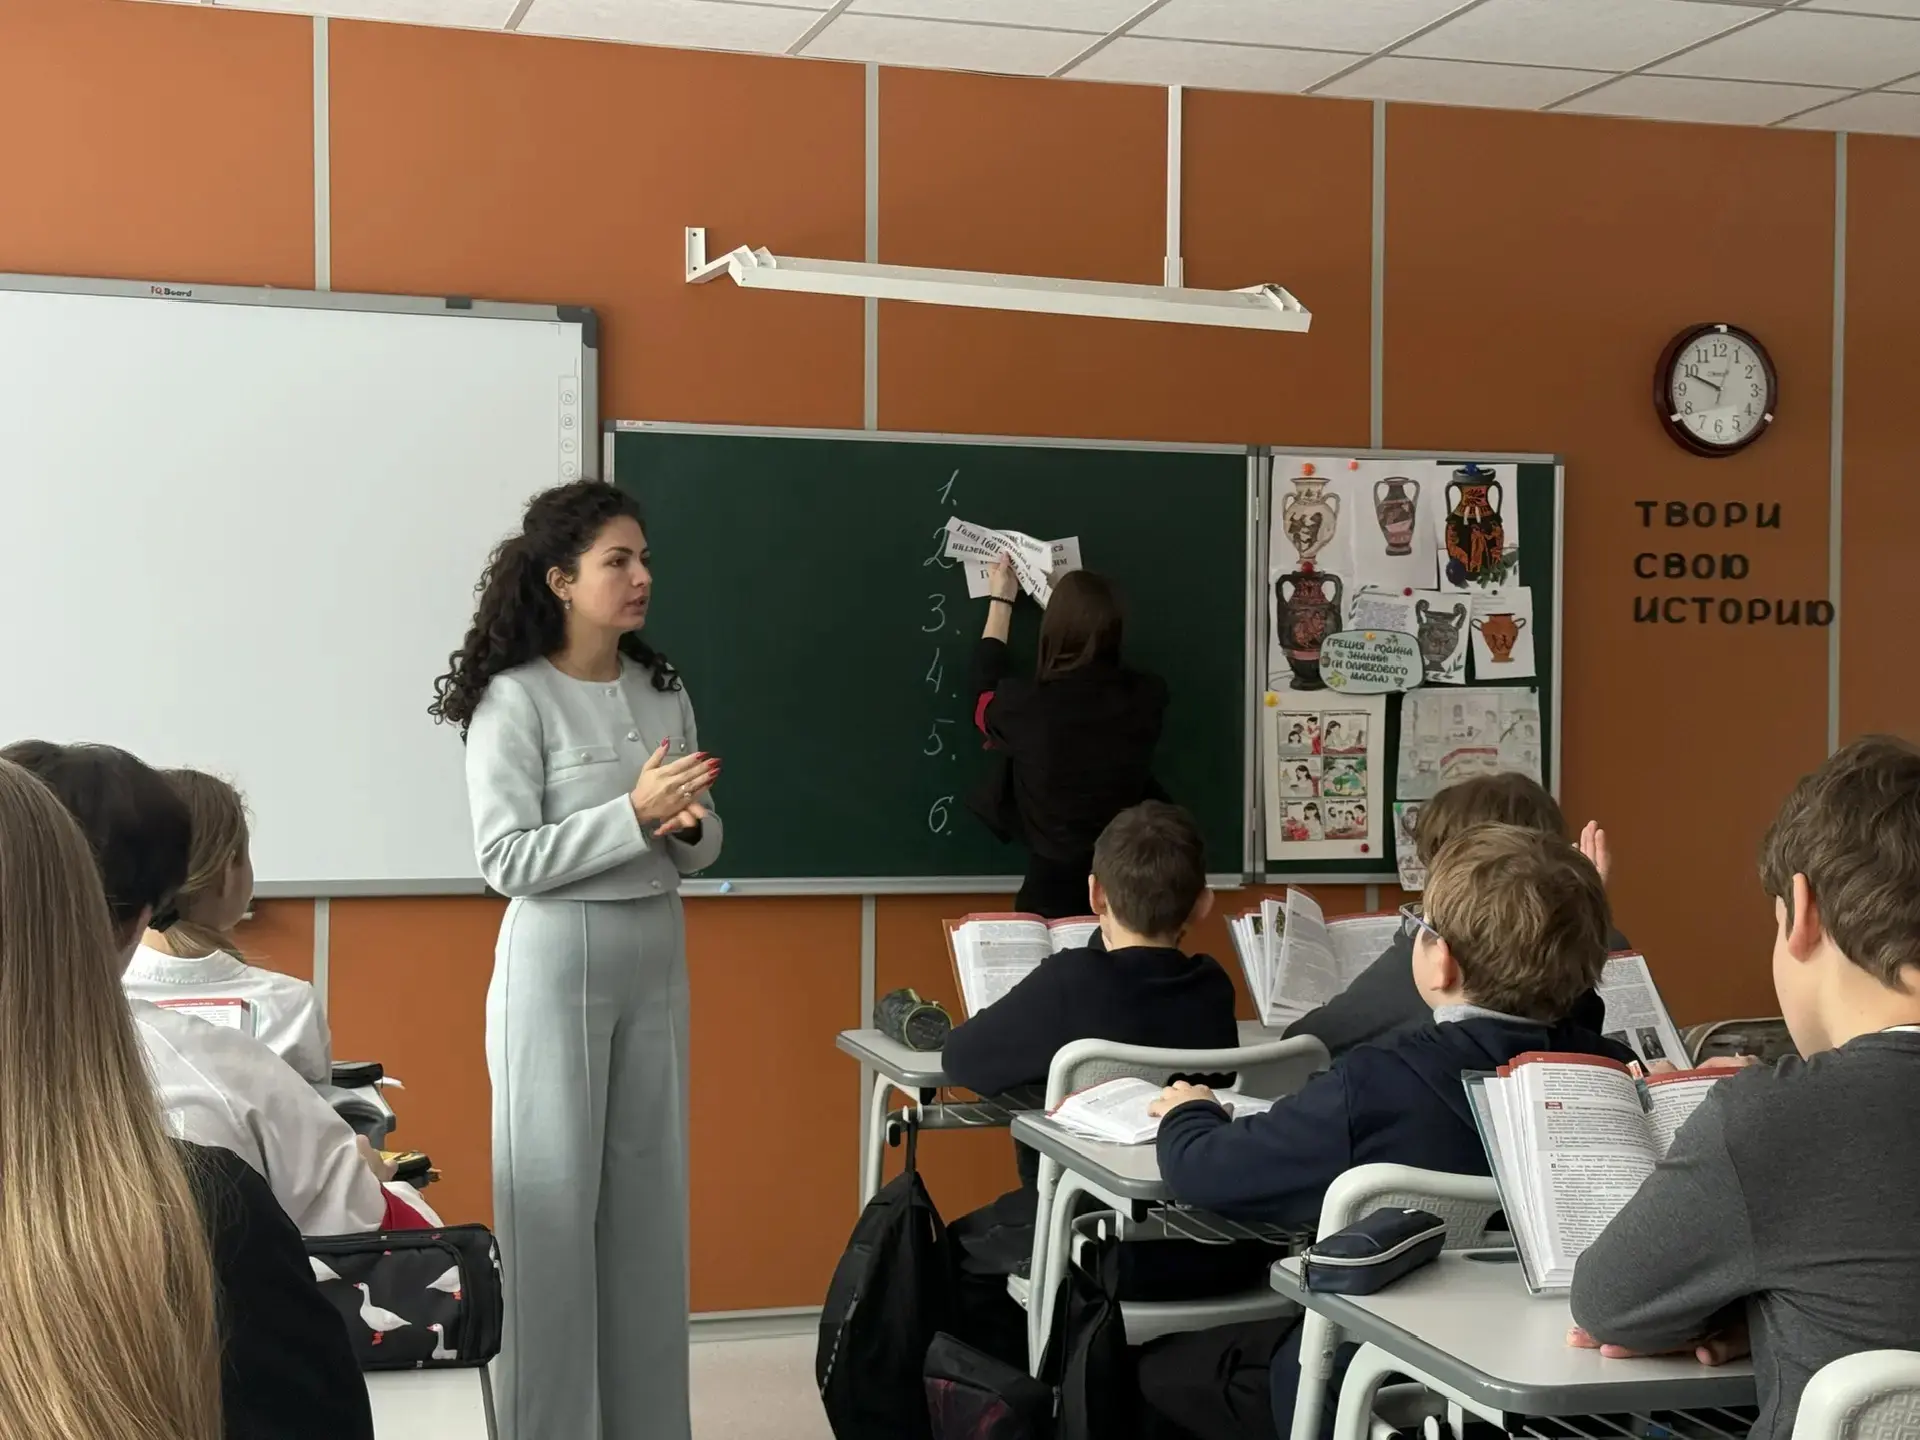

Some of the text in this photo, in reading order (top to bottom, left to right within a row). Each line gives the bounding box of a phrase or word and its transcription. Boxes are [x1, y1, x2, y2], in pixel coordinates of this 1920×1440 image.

[1695, 348, 1710, 364] 11
[1711, 342, 1728, 358] 12
[1733, 349, 1741, 364] 1
[1683, 363, 1699, 379] 10
[1744, 364, 1754, 380] 2
[1678, 382, 1687, 397] 9
[1750, 383, 1760, 399] 3
[1684, 400, 1693, 416] 8
[1743, 402, 1752, 416] 4
[1698, 414, 1707, 430] 7
[1713, 418, 1723, 434] 6
[1732, 414, 1741, 431] 5
[937, 469, 960, 506] 1.
[1634, 500, 1781, 529] ТВОРИ
[1633, 552, 1749, 580] СВОЮ
[922, 593, 961, 635] 3.
[1633, 596, 1835, 627] ИСТОРИЮ
[1326, 637, 1365, 650] ГРЕЦИЯ
[1374, 643, 1413, 656] РОДИНА
[926, 647, 957, 698] 4.
[1345, 661, 1409, 675] ОЛИВКОВОГО
[923, 718, 956, 761] 5.
[928, 795, 955, 836] 6.
